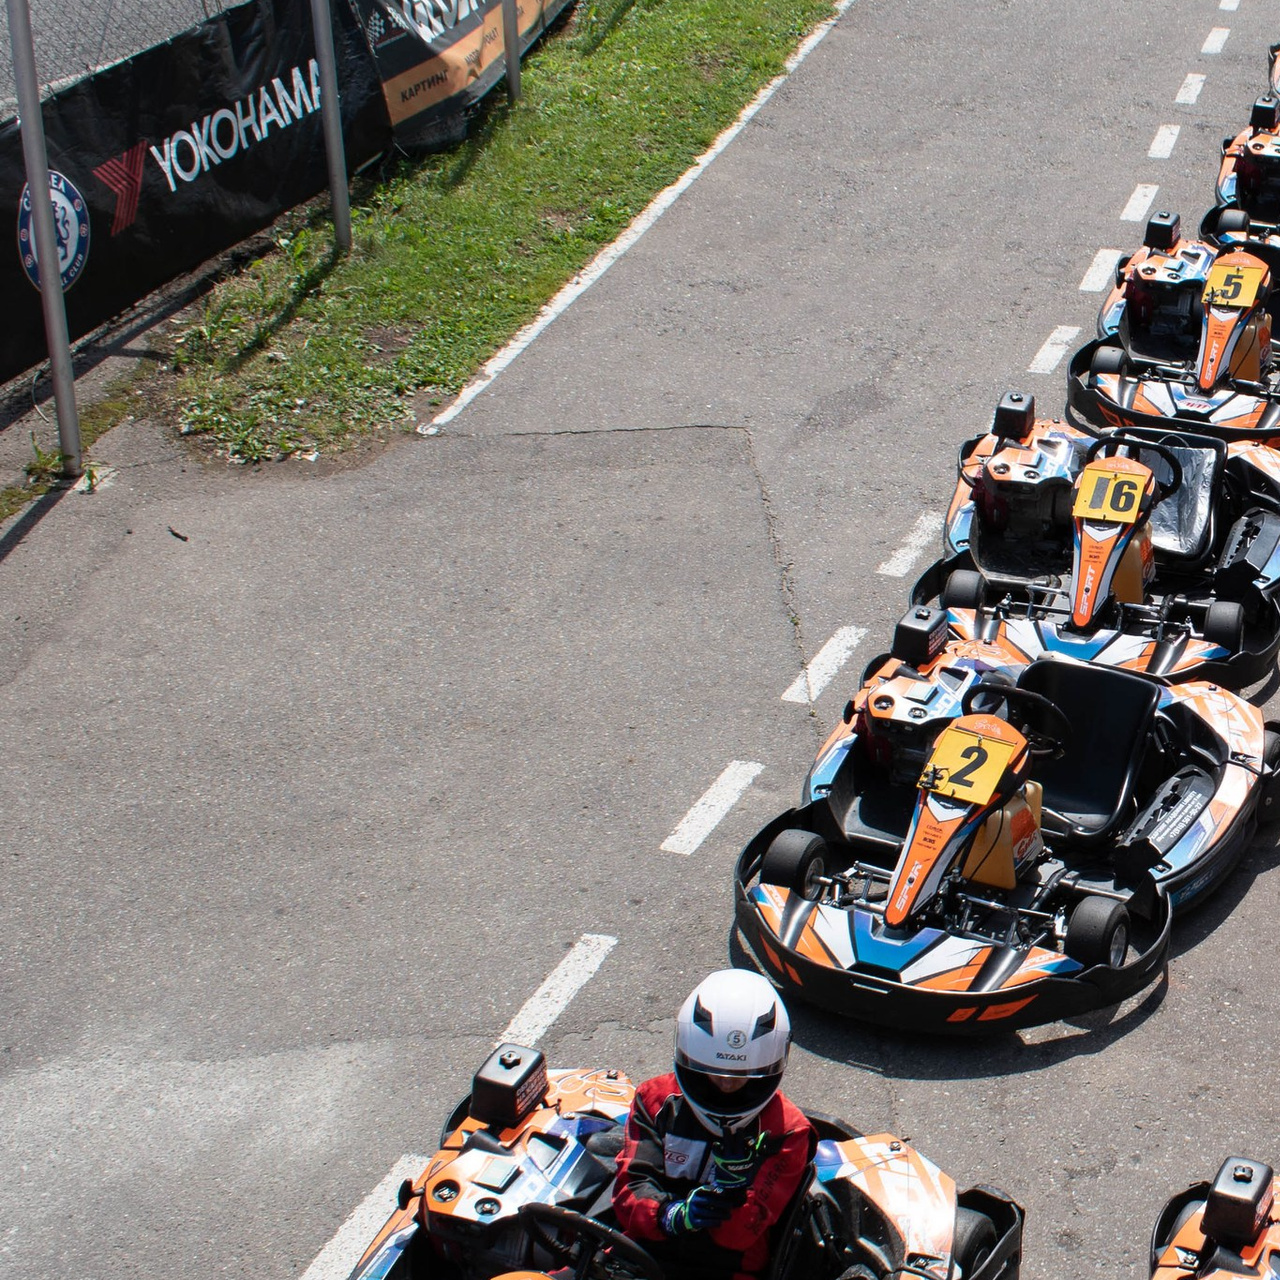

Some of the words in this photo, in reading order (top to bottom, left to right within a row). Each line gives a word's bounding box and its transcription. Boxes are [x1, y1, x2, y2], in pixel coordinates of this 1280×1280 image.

[1222, 274, 1244, 300] 5
[1205, 339, 1219, 381] SPORT
[1089, 476, 1138, 512] 16
[1079, 565, 1095, 616] SPORT
[948, 746, 988, 788] 2
[716, 1052, 747, 1062] ATAKI
